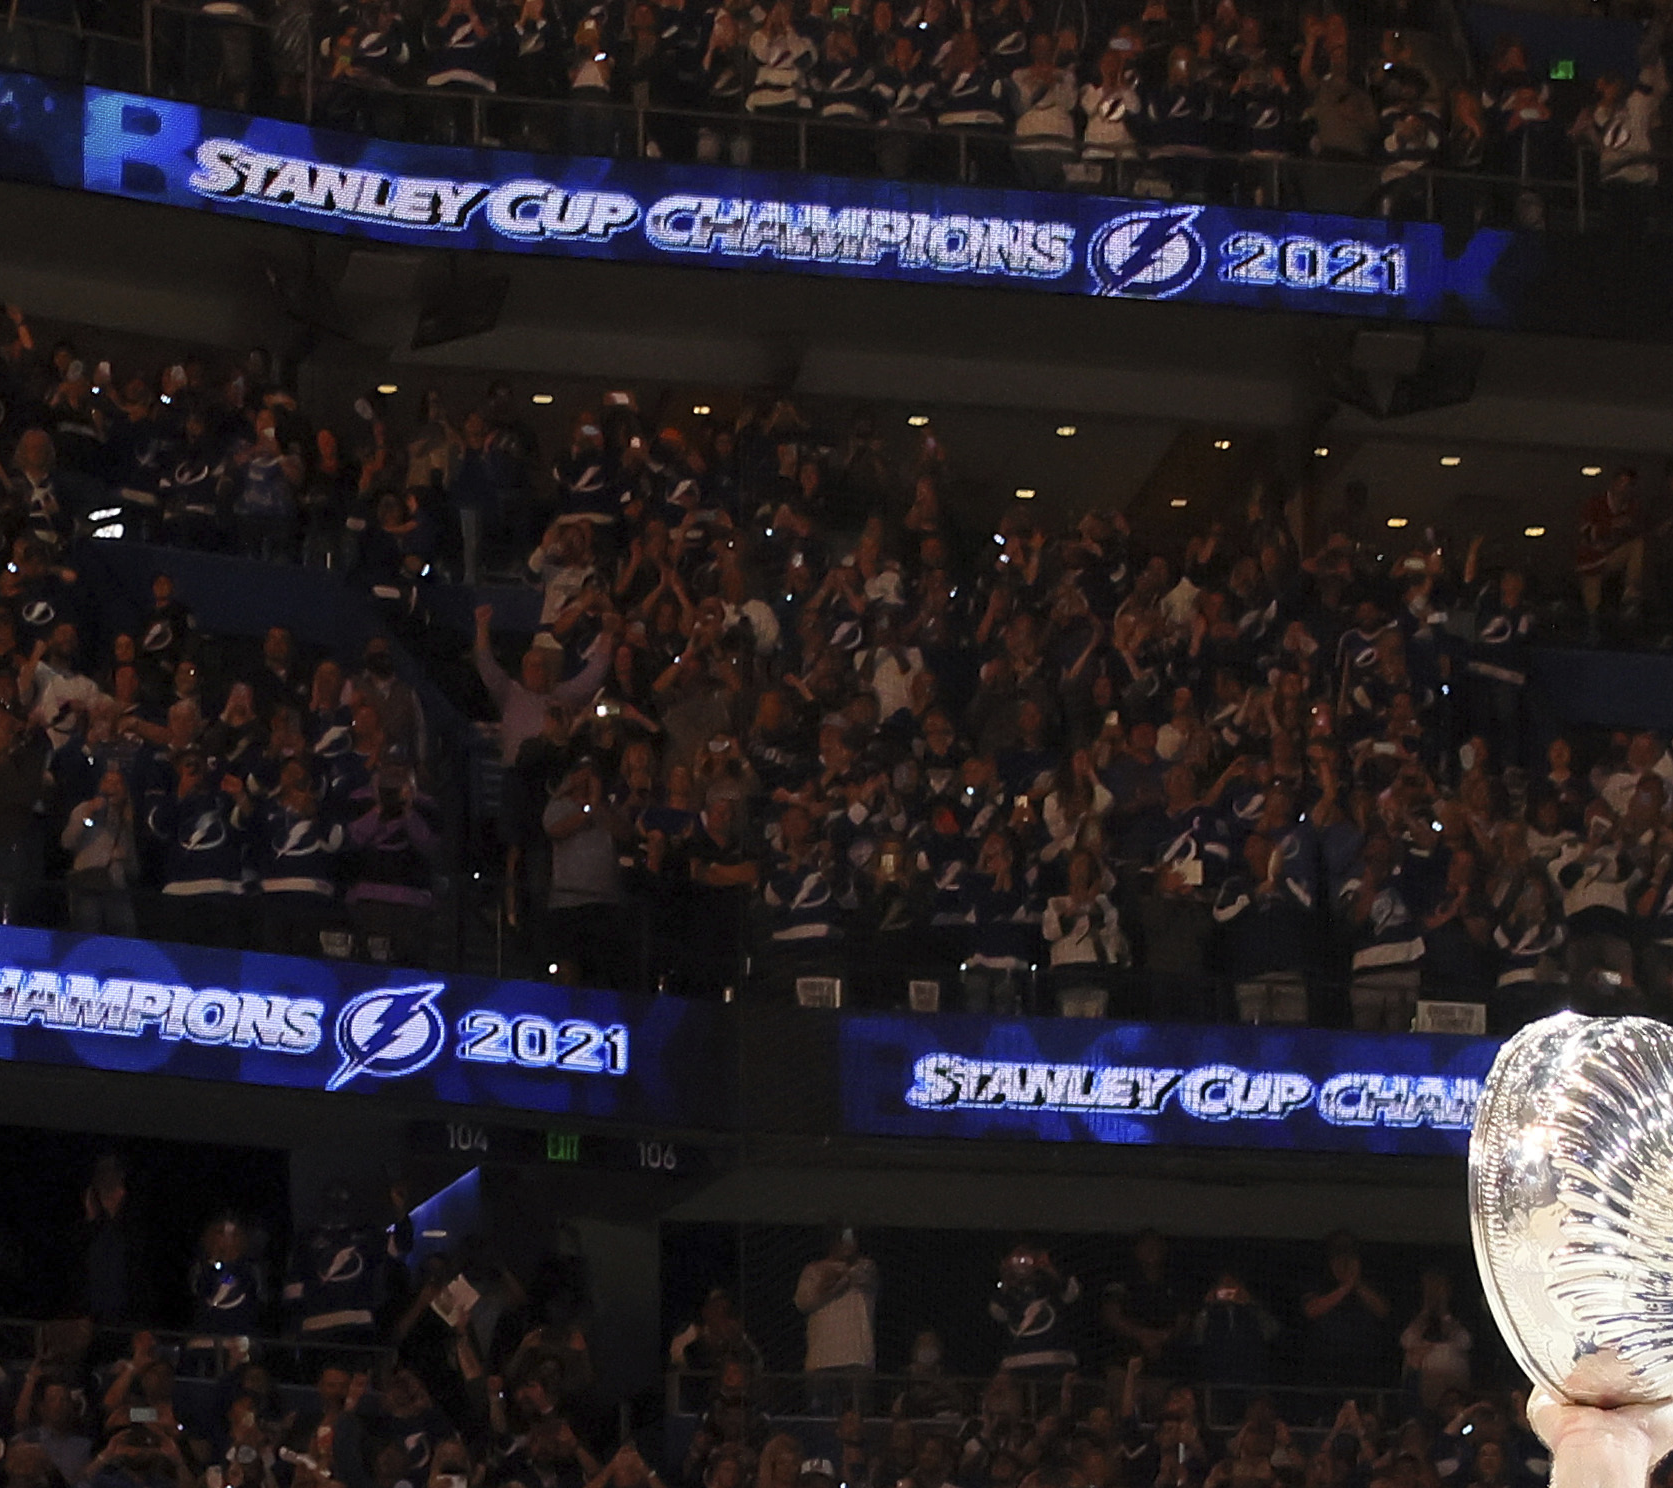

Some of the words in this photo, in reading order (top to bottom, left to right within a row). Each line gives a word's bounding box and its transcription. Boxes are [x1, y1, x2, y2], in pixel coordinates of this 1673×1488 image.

[188, 136, 490, 232] STANLEY
[486, 179, 640, 243] CUP
[644, 192, 1075, 281] CHAMPIONS
[1221, 230, 1408, 297] 2021
[456, 1008, 629, 1076] 2021
[905, 1051, 1185, 1116] STANLEY
[1179, 1062, 1317, 1122] CUP
[445, 1122, 488, 1152] 104
[637, 1141, 678, 1171] 106
